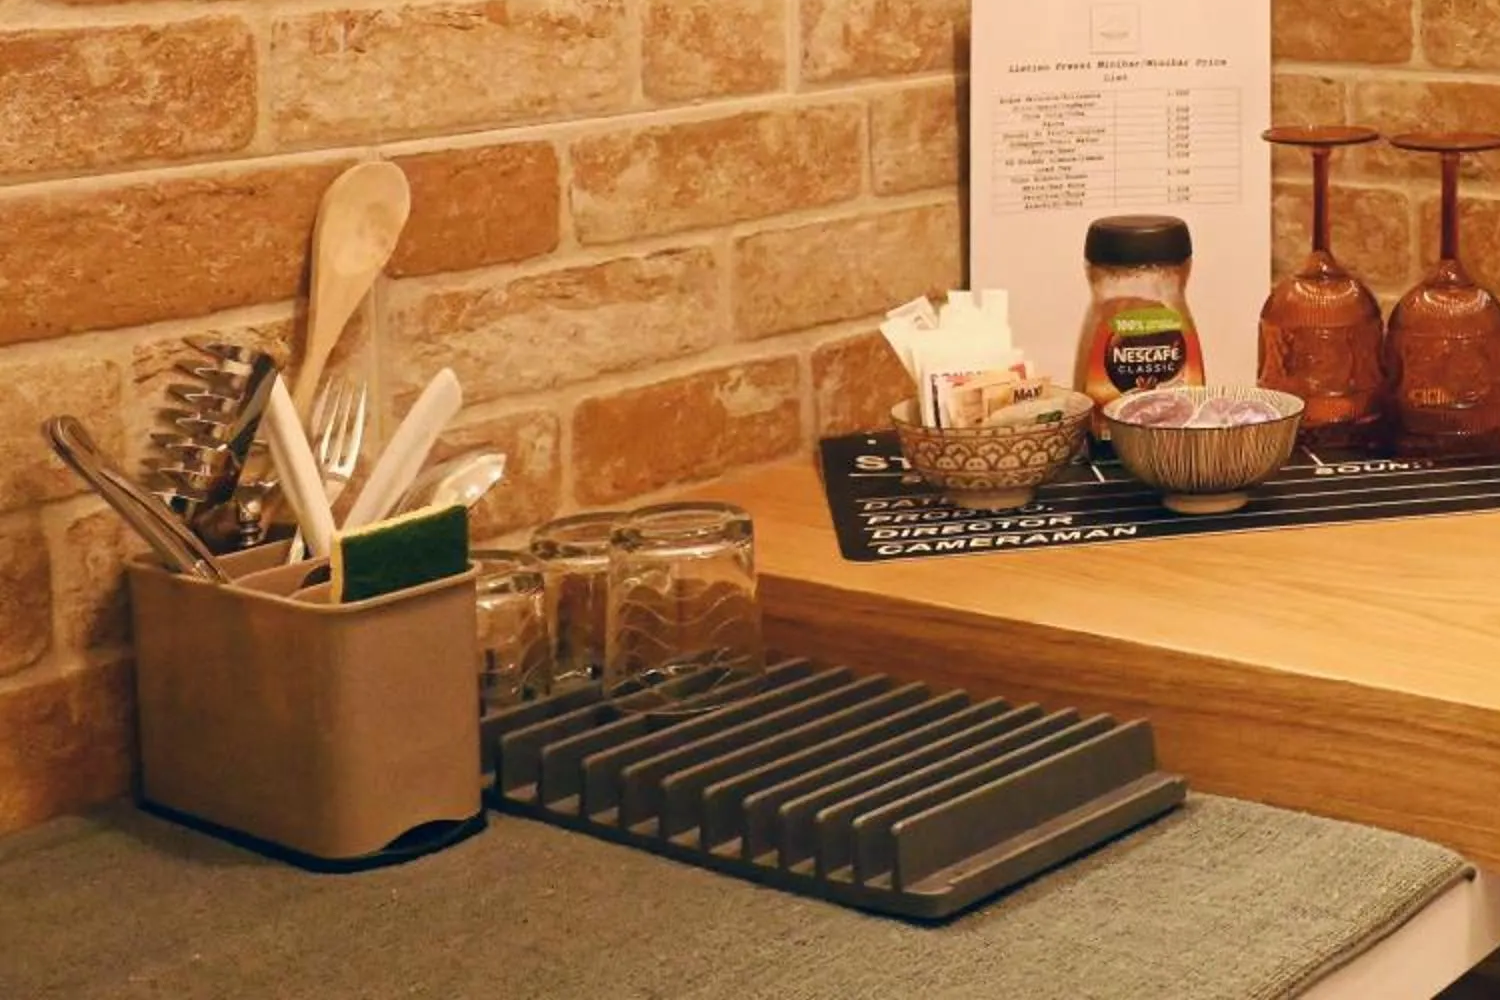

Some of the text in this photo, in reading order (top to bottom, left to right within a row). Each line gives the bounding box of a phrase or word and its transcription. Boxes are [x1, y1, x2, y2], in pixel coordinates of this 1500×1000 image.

[1117, 362, 1176, 374] CLASSIC
[871, 515, 1073, 540] DIRECTOR
[877, 525, 1137, 555] CAMERAMAN
